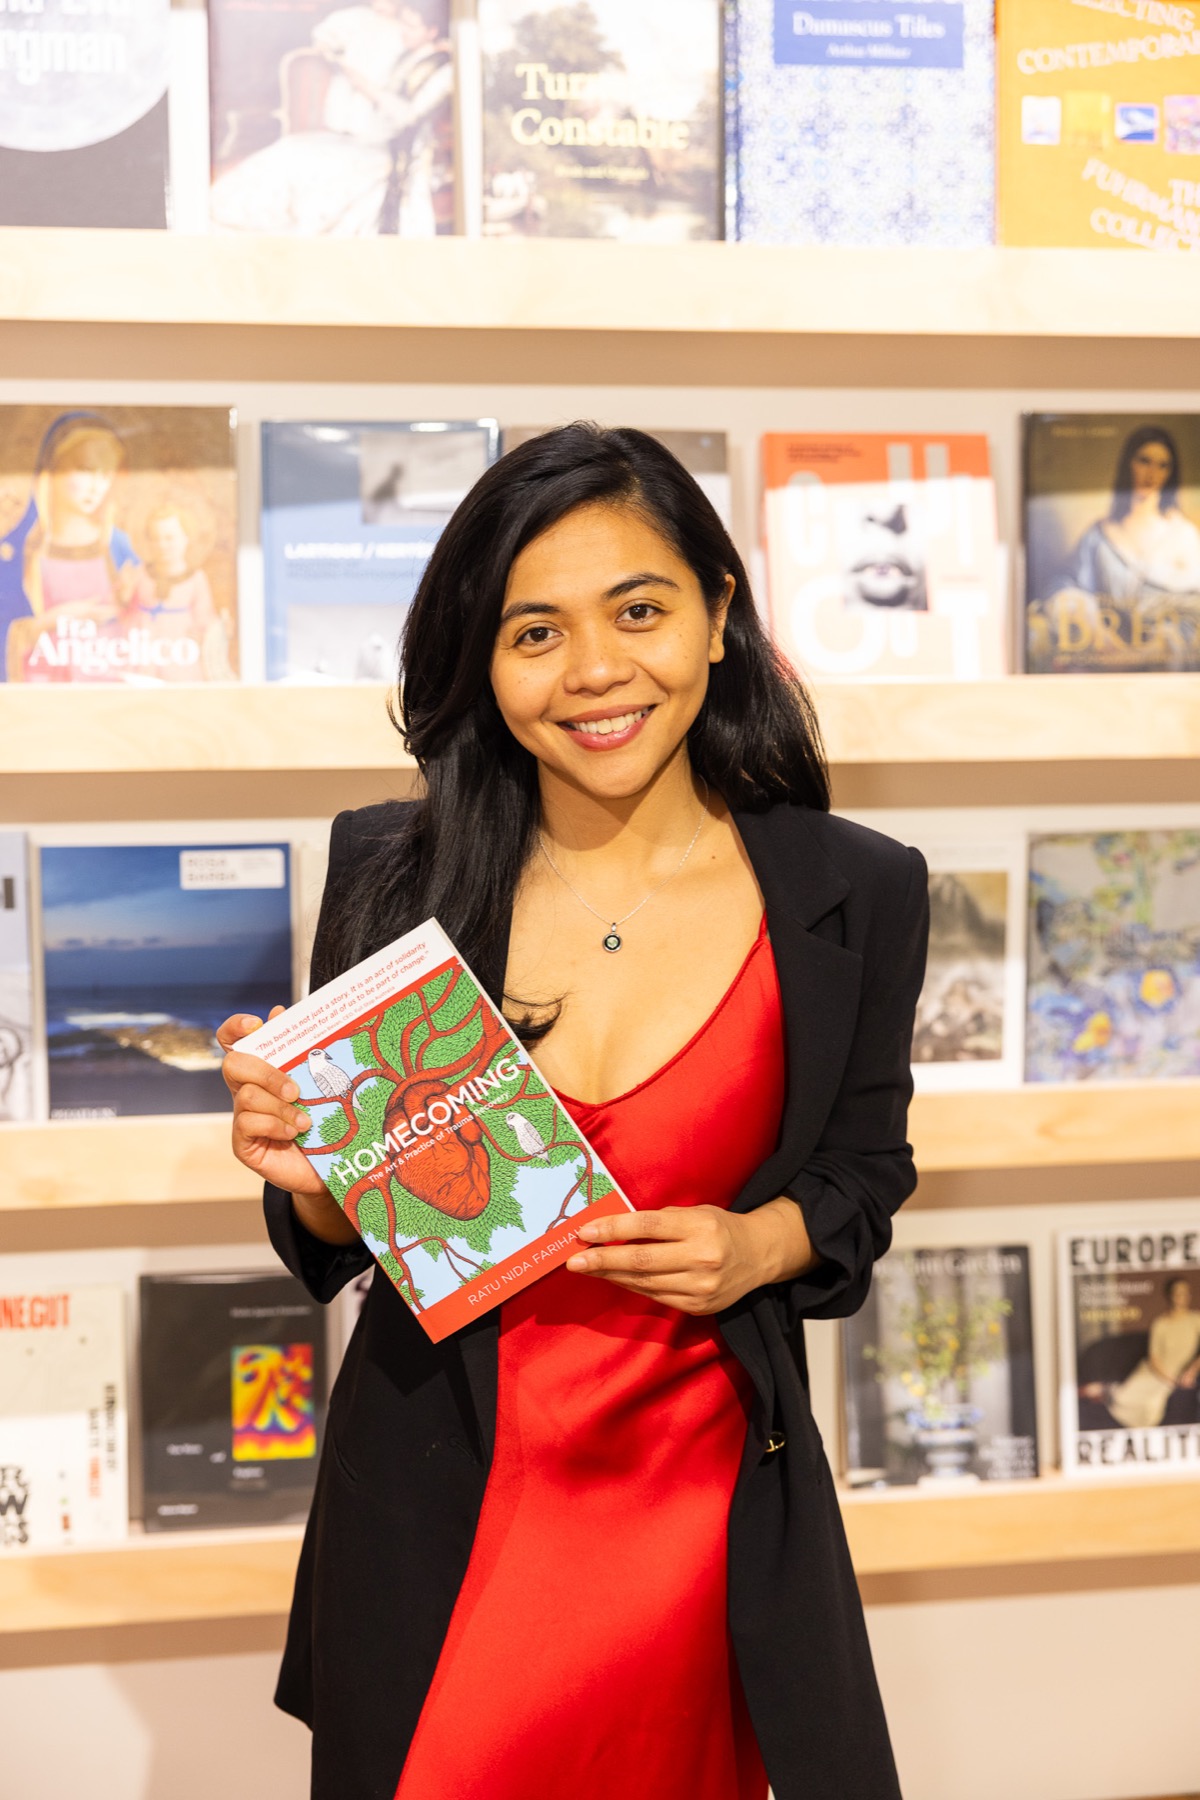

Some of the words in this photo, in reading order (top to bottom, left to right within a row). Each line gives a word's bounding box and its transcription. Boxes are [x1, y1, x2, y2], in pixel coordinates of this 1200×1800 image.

[511, 107, 690, 150] Constable
[29, 627, 200, 675] Angelico
[56, 614, 97, 639] Fra
[263, 1048, 278, 1061] and
[278, 1043, 287, 1052] an
[287, 1023, 319, 1046] invitation
[318, 1015, 329, 1024] for
[330, 1009, 339, 1018] all
[339, 1003, 347, 1012] of
[347, 998, 357, 1007] us
[356, 993, 366, 1001] to
[365, 986, 375, 995] be
[375, 975, 392, 989] part
[392, 969, 399, 979] of
[273, 1027, 292, 1042] book
[298, 1015, 311, 1026] not
[312, 1005, 325, 1019] just
[330, 991, 350, 1006] story.
[351, 985, 357, 993] It
[356, 981, 365, 989] is
[364, 975, 374, 984] an
[374, 967, 386, 978] act
[386, 960, 395, 970] of
[395, 943, 427, 964] solidarity
[314, 1029, 328, 1039] Karen
[364, 998, 376, 1008] Stop
[375, 985, 396, 1000] Australia
[333, 1057, 520, 1184] HOMECOMING
[368, 1171, 384, 1182] The
[385, 1162, 398, 1173] Art
[404, 1138, 436, 1160] Practice
[436, 1130, 445, 1140] of
[445, 1114, 475, 1133] Trauma
[473, 1091, 510, 1116] Recovery
[1071, 1233, 1200, 1266] EUROPE
[468, 1279, 501, 1305] RATU
[501, 1261, 533, 1283] NIDA
